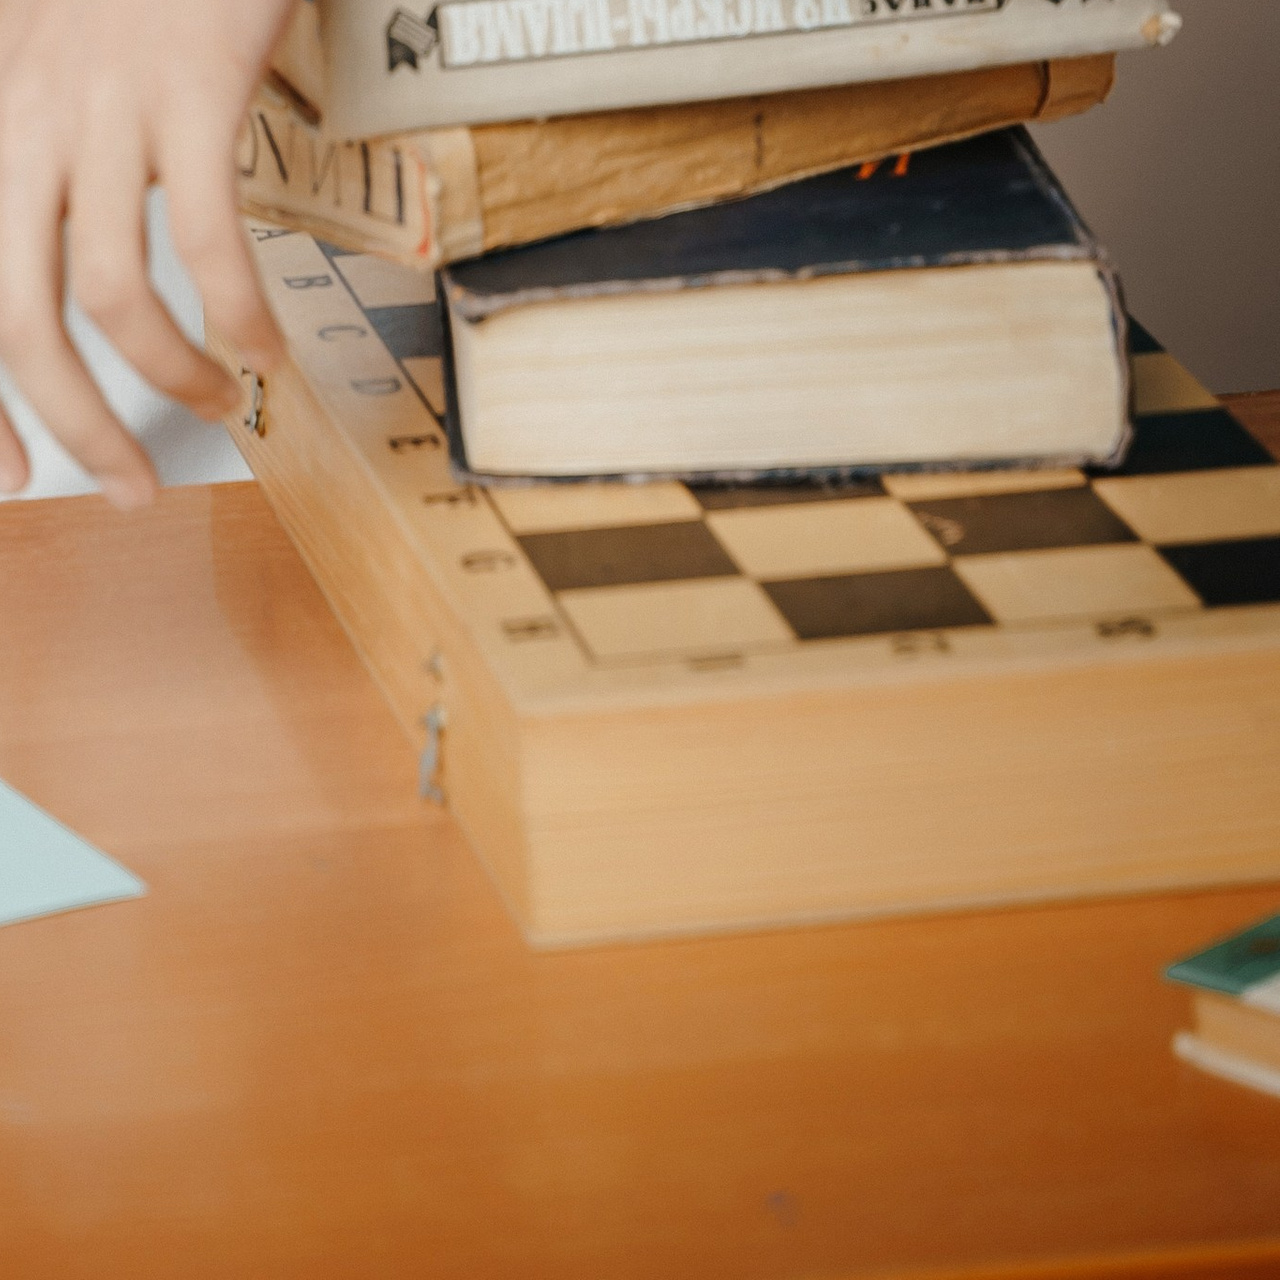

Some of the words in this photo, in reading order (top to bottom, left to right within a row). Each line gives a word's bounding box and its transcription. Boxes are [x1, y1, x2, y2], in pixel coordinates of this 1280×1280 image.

[283, 274, 333, 290] B
[317, 324, 368, 339] C
[350, 377, 402, 395] D
